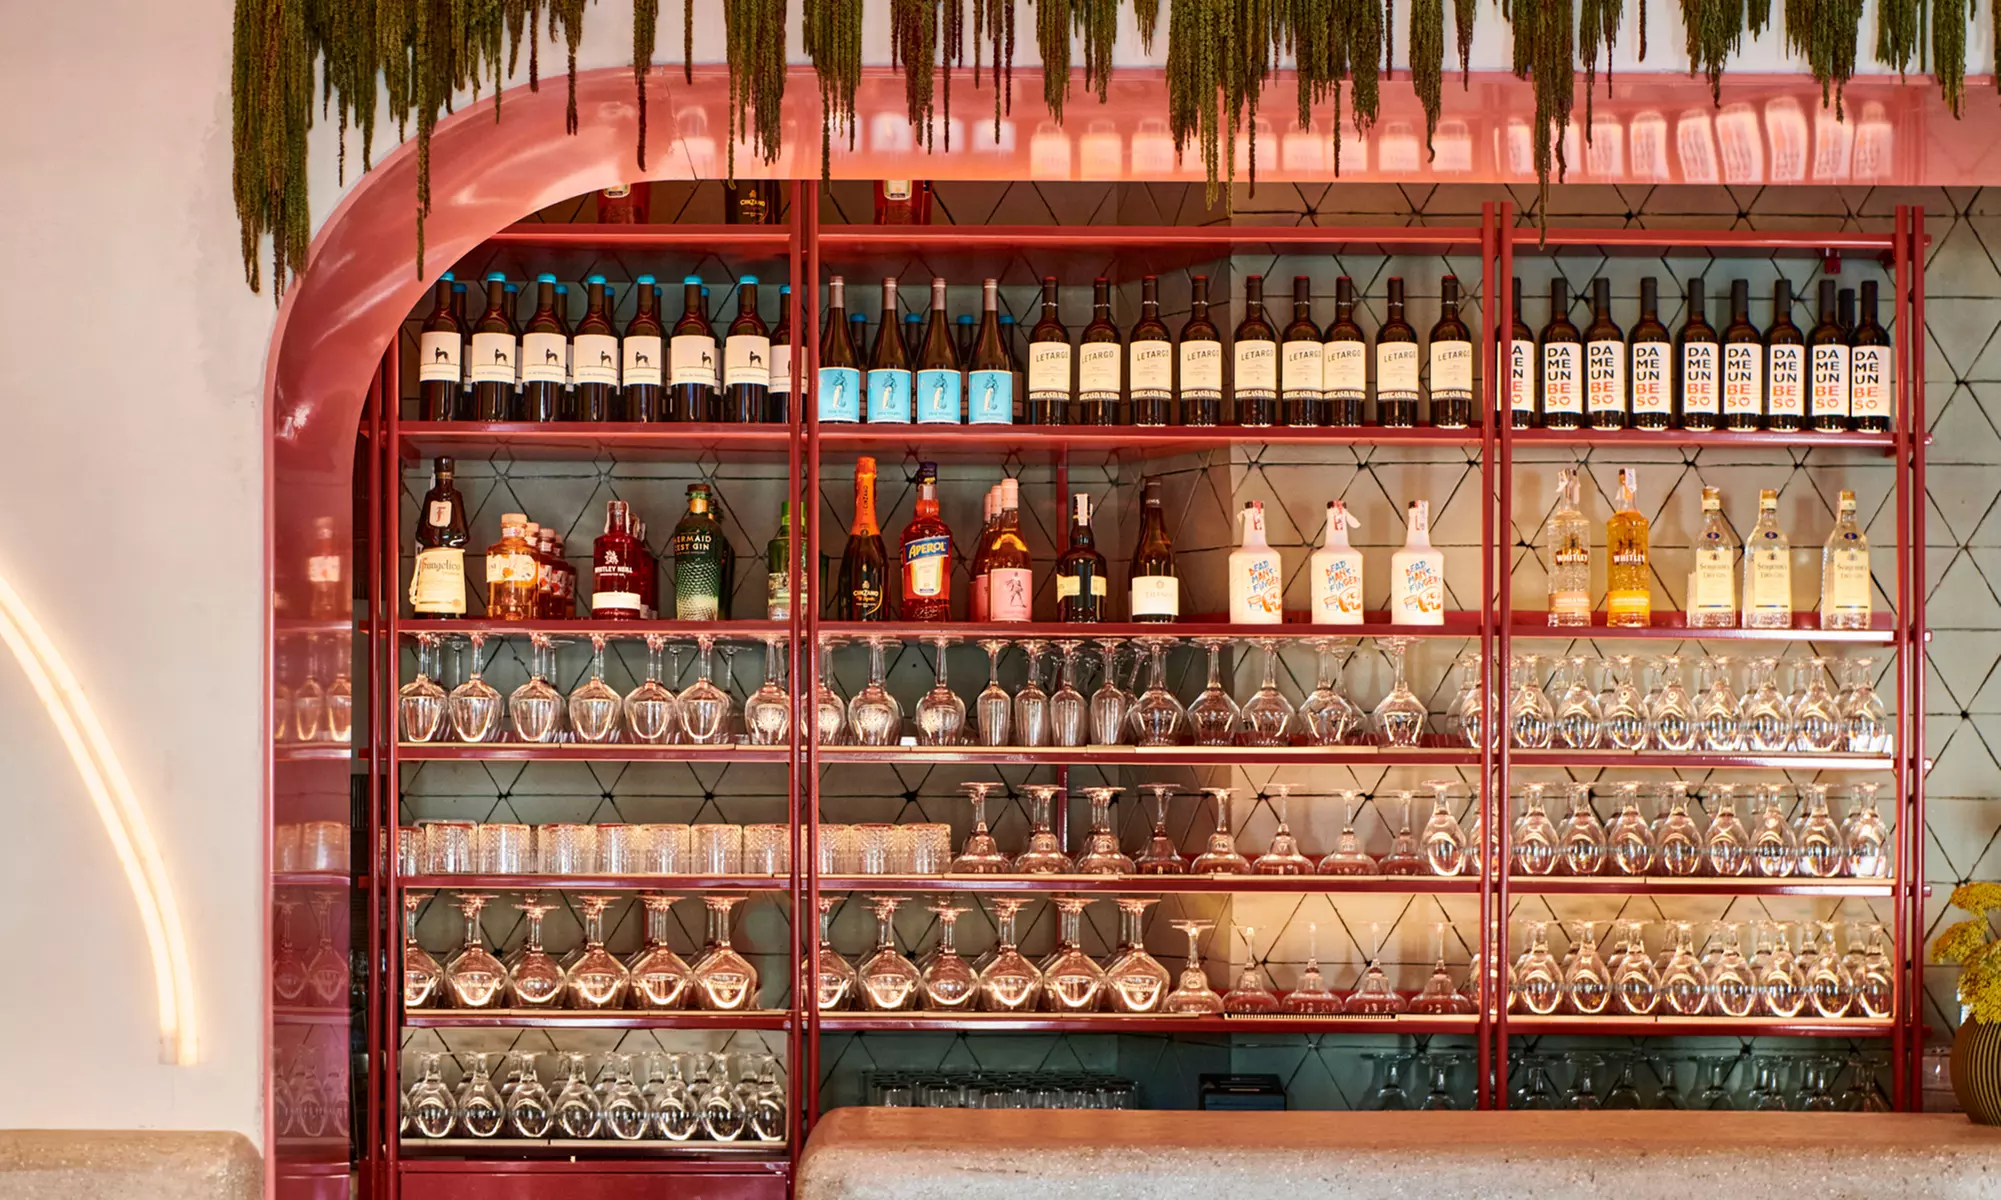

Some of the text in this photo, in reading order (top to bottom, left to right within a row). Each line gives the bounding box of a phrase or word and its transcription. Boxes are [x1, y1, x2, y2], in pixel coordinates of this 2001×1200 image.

[1328, 349, 1361, 362] LETARGO
[1548, 347, 1570, 358] DA
[1591, 346, 1613, 356] DA
[1636, 347, 1659, 357] DA
[1688, 347, 1710, 357] DA
[1728, 348, 1751, 358] DA
[1774, 349, 1796, 359] DA
[1816, 349, 1839, 360] DA
[1855, 351, 1878, 361] DA
[1082, 350, 1114, 364] LETARGO
[1548, 359, 1571, 369] ME
[1591, 357, 1614, 368] ME
[1636, 359, 1659, 369] ME
[1688, 359, 1711, 369] ME
[1728, 360, 1751, 370] ME
[1774, 361, 1797, 371] ME
[1816, 361, 1839, 371] ME
[1855, 362, 1879, 373] ME
[1548, 371, 1571, 381] UN
[1591, 369, 1614, 380] UN
[1636, 371, 1659, 381] UN
[1688, 371, 1711, 381] UN
[1728, 372, 1751, 382] UN
[1774, 373, 1797, 383] UN
[1816, 373, 1839, 383] UN
[1855, 374, 1879, 384] UN
[1548, 383, 1570, 394] BE
[1591, 382, 1613, 392] BE
[1636, 383, 1659, 394] BE
[1688, 383, 1710, 394] BE
[1727, 384, 1750, 395] BE
[1773, 385, 1796, 396] BE
[1816, 386, 1839, 396] BE
[1854, 387, 1878, 398] BE
[1549, 396, 1570, 405] SO
[1592, 395, 1613, 404] SO
[1637, 396, 1659, 405] SO
[1688, 396, 1710, 405] SO
[1728, 397, 1750, 406] SO
[1774, 399, 1795, 407] SO
[1817, 399, 1838, 408] SO
[1855, 400, 1877, 408] SO
[692, 543, 709, 551] GIN
[908, 542, 946, 559] APEROL
[1556, 554, 1588, 562] WHITLEY
[1613, 554, 1645, 562] WHITLEY
